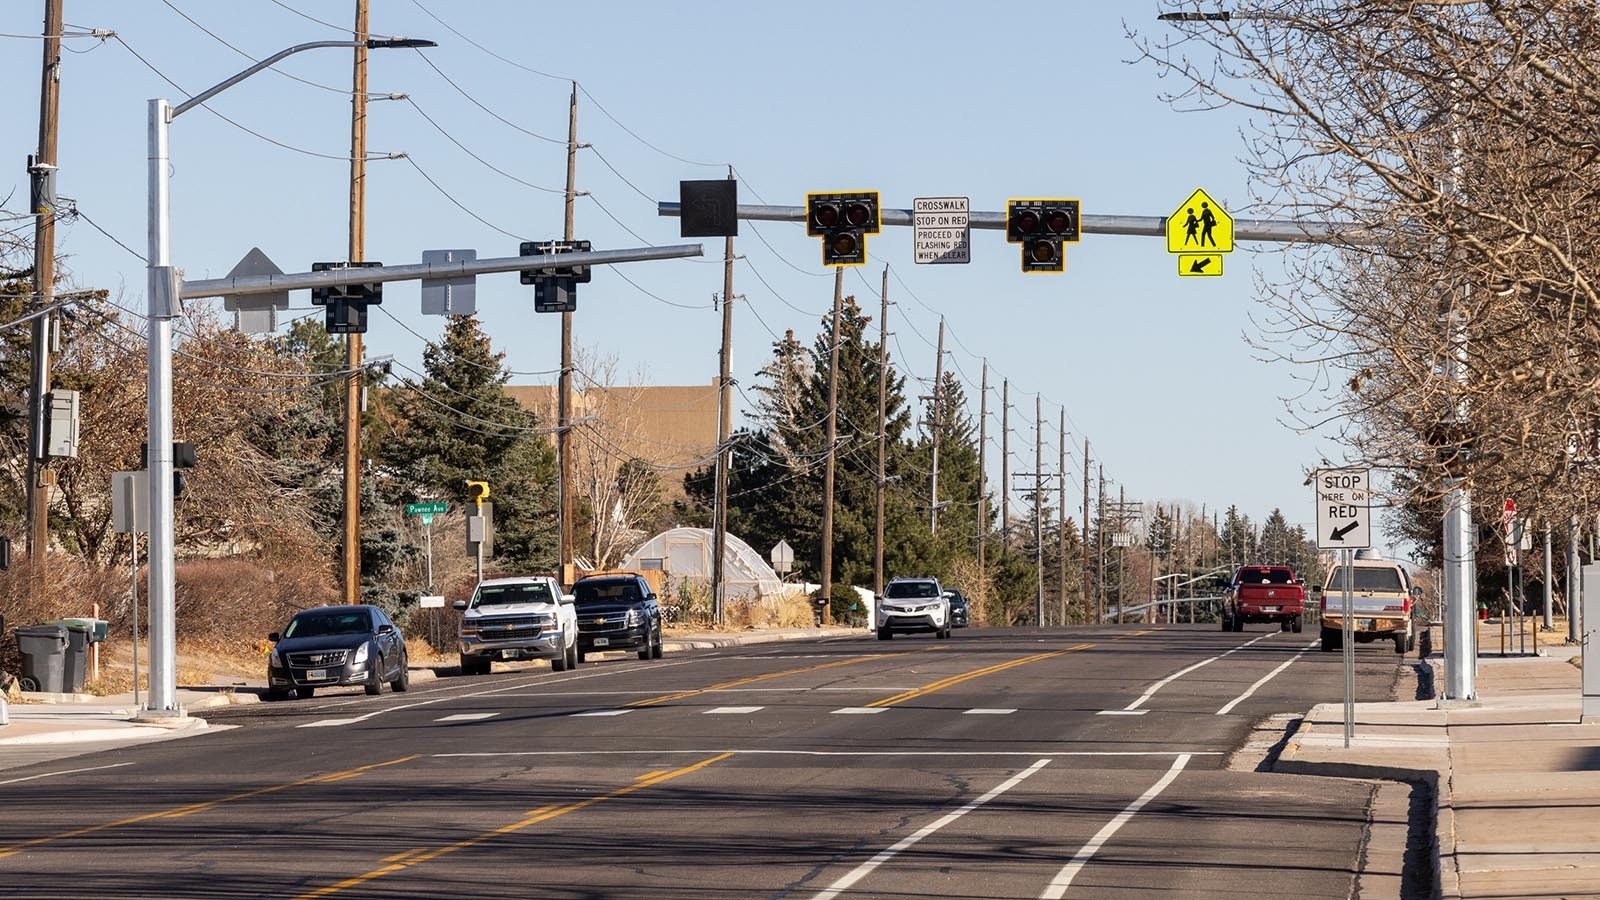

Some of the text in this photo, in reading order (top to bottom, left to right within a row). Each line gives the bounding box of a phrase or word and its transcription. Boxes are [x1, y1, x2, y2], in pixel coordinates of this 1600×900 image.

[917, 201, 965, 210] CROSSWALK
[916, 216, 967, 225] STOP ON RED
[918, 230, 966, 239] PROCEED ON
[917, 241, 967, 249] FLASHING RED
[918, 251, 966, 260] WHEN CLEAR
[1324, 476, 1361, 489] STOP
[1321, 492, 1364, 501] HERE ON
[1329, 505, 1358, 518] RED
